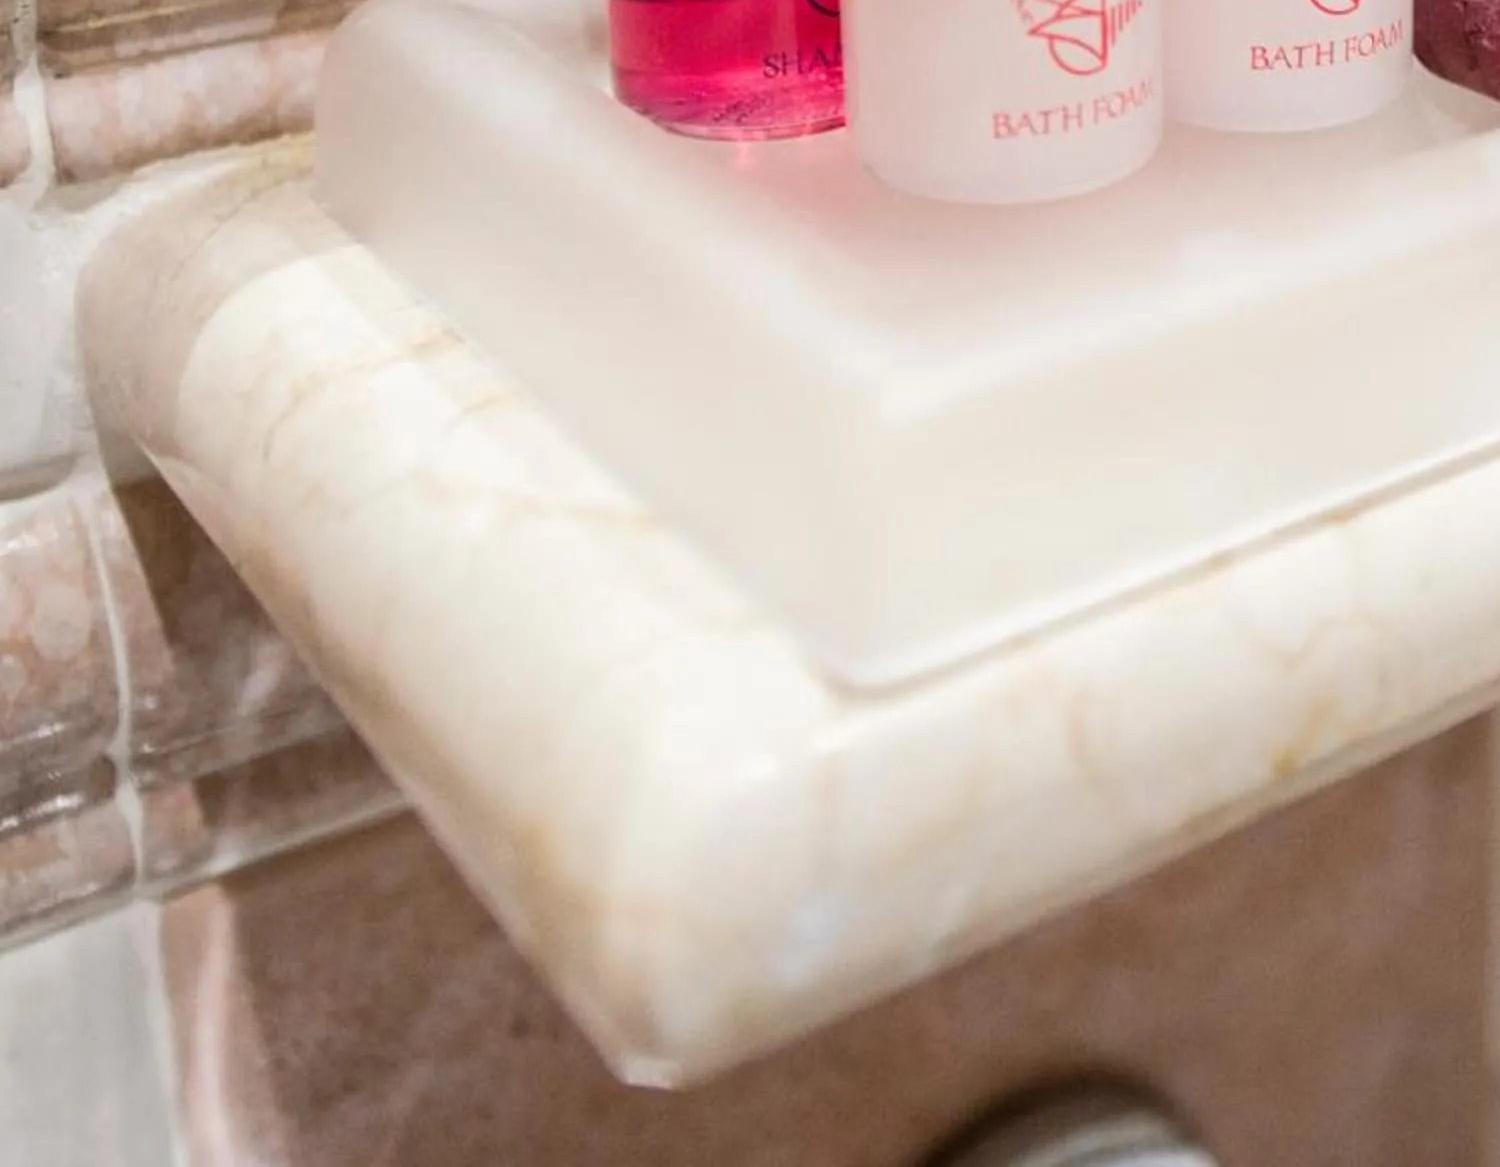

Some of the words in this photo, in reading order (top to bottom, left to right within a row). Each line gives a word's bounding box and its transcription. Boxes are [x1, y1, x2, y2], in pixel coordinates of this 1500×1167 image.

[1250, 40, 1335, 71] BATH
[1343, 18, 1404, 62] FOAM
[992, 101, 1084, 139] BATH
